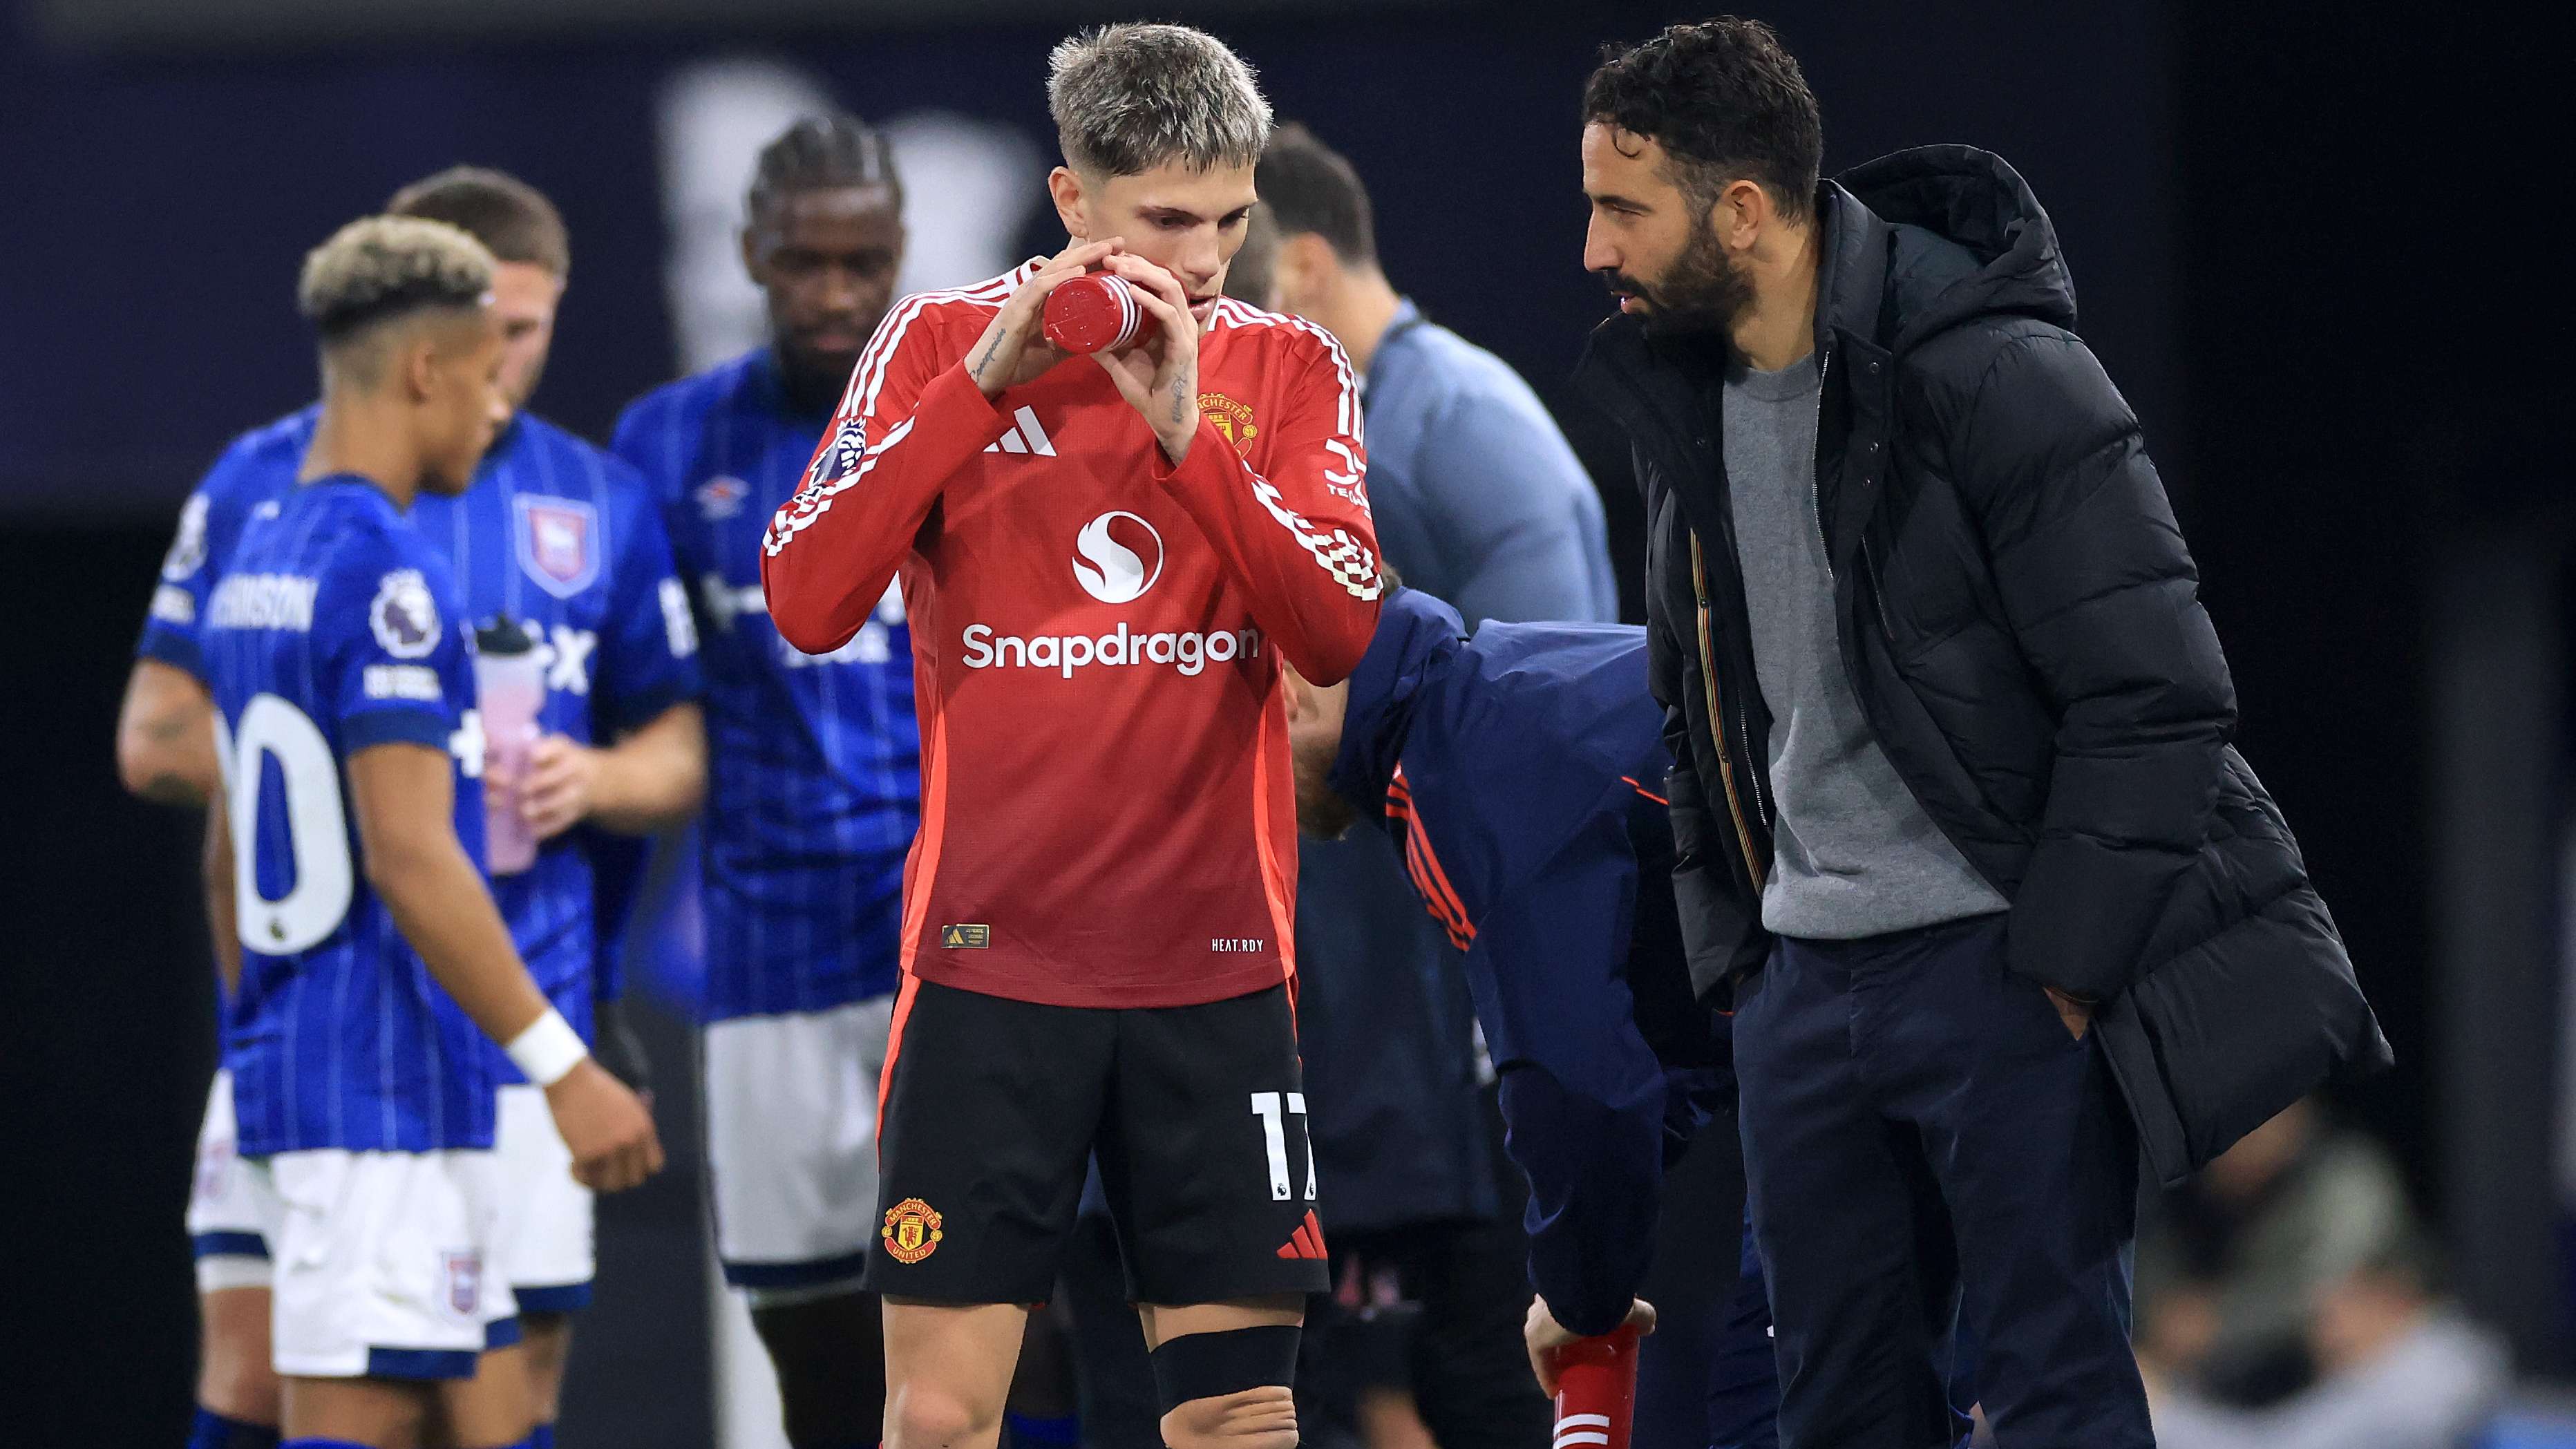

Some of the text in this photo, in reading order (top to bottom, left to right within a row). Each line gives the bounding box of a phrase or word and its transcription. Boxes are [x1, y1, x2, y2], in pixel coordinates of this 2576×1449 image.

[963, 622, 1259, 679] Snapdragon
[1211, 938, 1264, 952] HEAT.RDY
[1251, 1091, 1316, 1201] 17
[889, 1202, 937, 1226] MANCHESTER
[893, 1248, 926, 1259] UNITED
